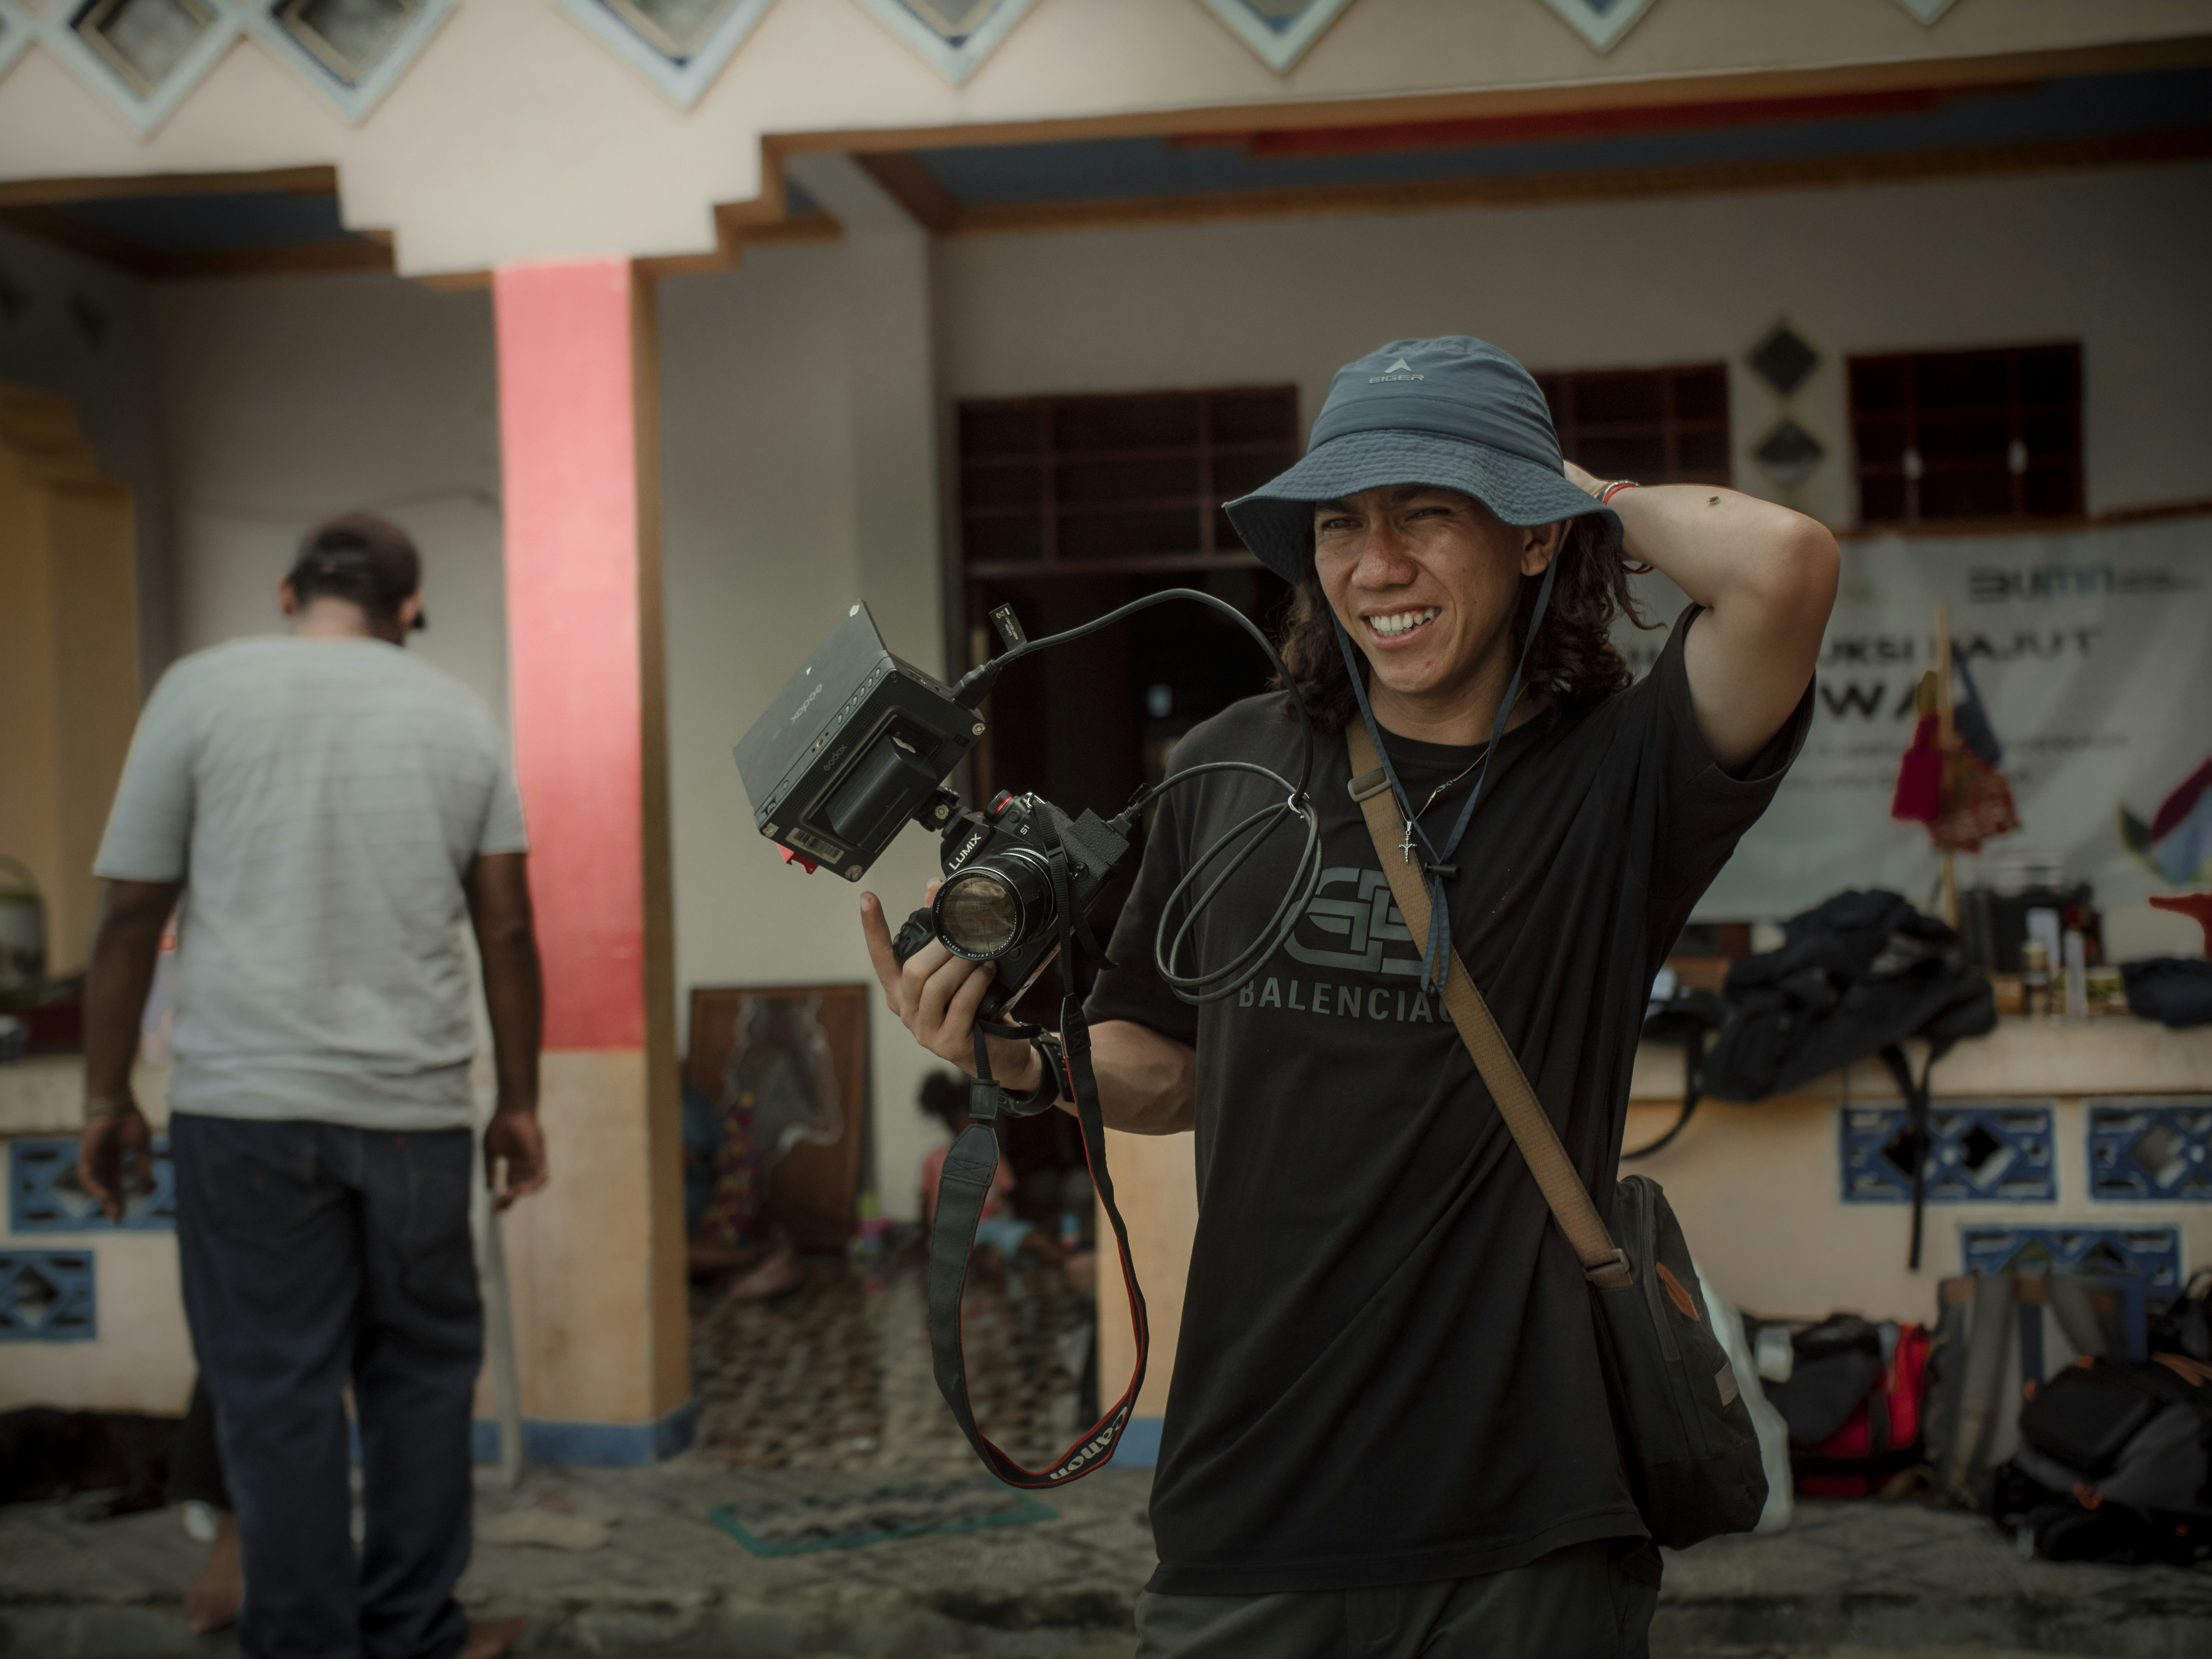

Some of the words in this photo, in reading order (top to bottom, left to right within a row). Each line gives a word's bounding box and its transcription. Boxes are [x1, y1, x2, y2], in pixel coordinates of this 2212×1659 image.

[1369, 374, 1425, 384] EIGER
[791, 684, 822, 724] Godox
[824, 744, 847, 771] Godox
[1020, 824, 1030, 835] S1
[949, 833, 981, 870] LUMIX
[1050, 1406, 1128, 1480] Canon
